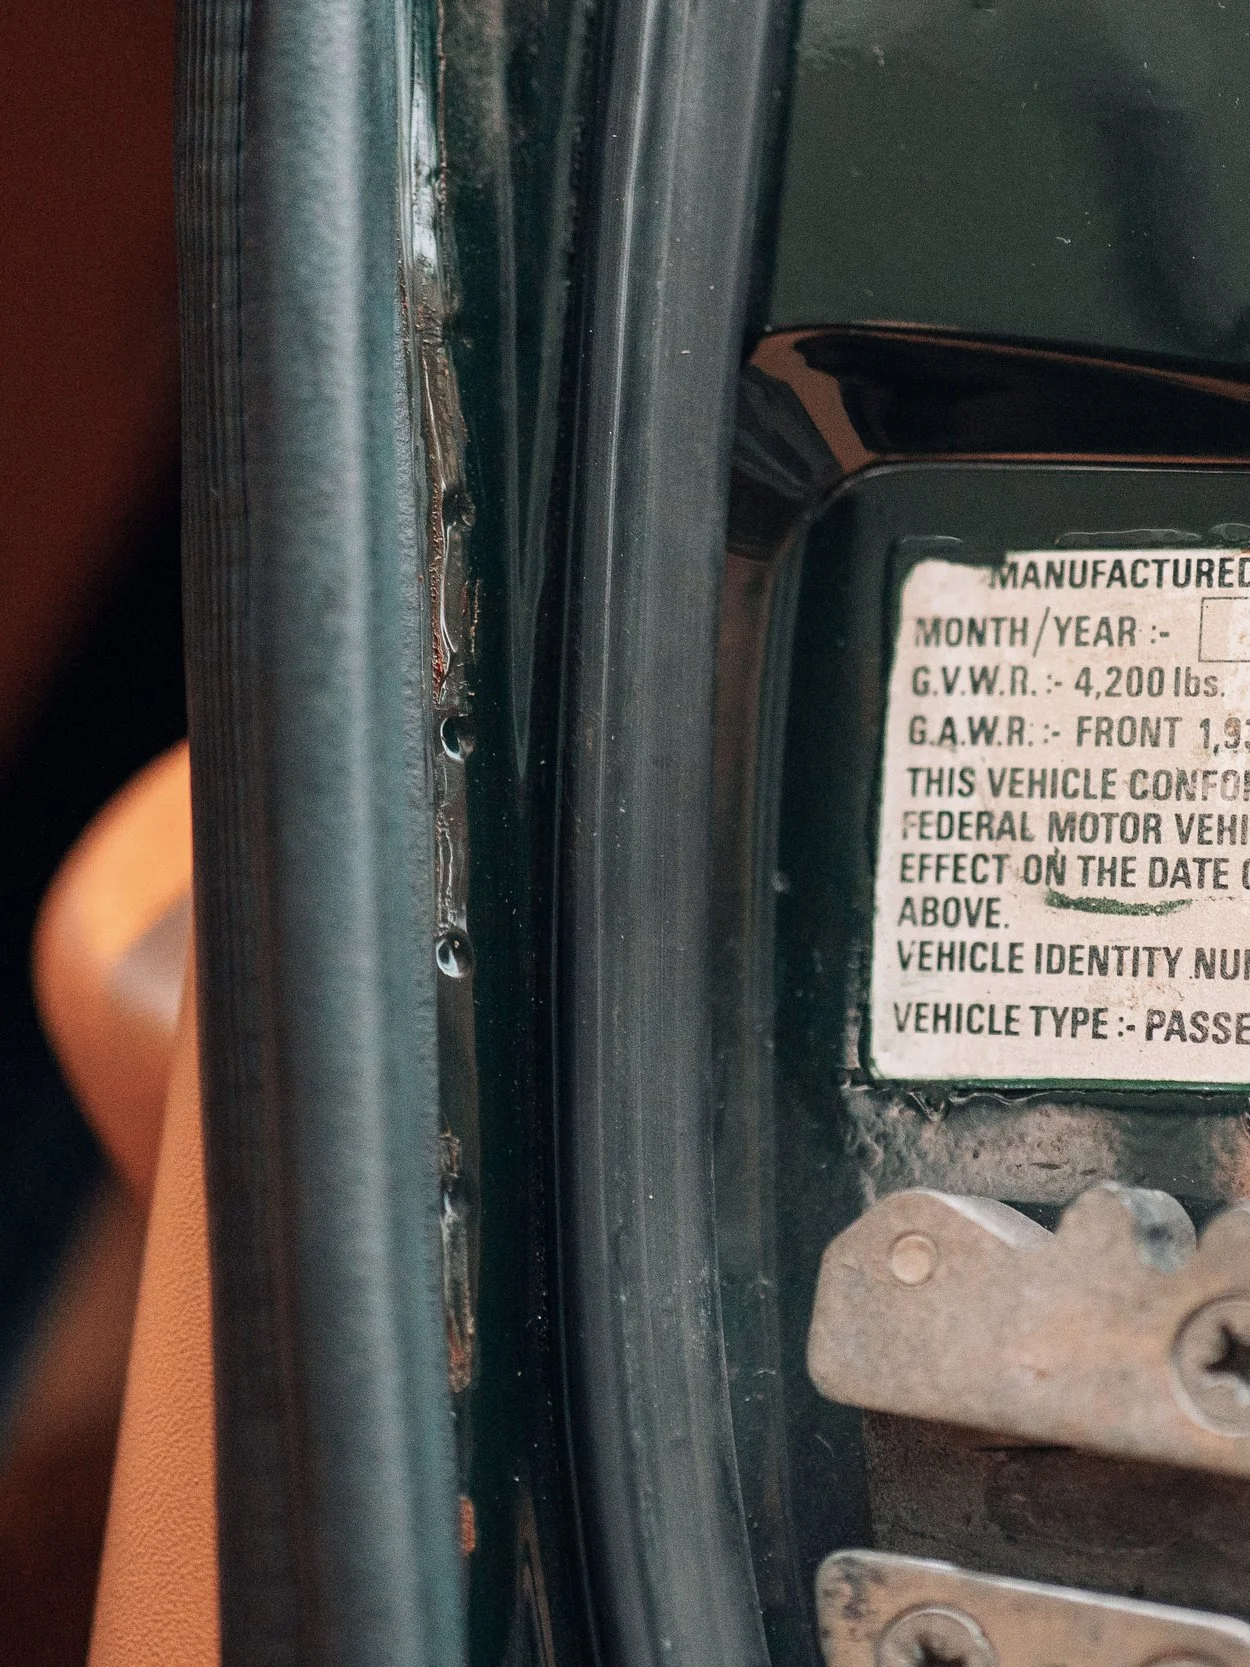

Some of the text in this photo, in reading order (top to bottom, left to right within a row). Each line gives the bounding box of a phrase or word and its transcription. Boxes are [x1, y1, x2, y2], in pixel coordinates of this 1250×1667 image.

[915, 606, 1138, 657] MONTH/YEAR
[1074, 666, 1164, 700] 4,200
[1175, 666, 1225, 698] lbs.
[1077, 717, 1182, 748] FRONT
[906, 768, 976, 799] THIS
[988, 768, 1117, 801] VEHICLE
[903, 811, 1034, 842] FEDERAL
[1048, 812, 1162, 845] MOTOR
[900, 854, 1010, 884] EFFECT
[1024, 855, 1066, 886] ON
[1077, 856, 1136, 887] THE
[1148, 857, 1229, 890] DATE
[897, 897, 1010, 929] ABOVE.
[897, 941, 1024, 974] VEHICLE
[1035, 943, 1182, 978] IDENTITY
[894, 1003, 1020, 1037] VEHICLE
[1030, 1005, 1108, 1040] TYPE
